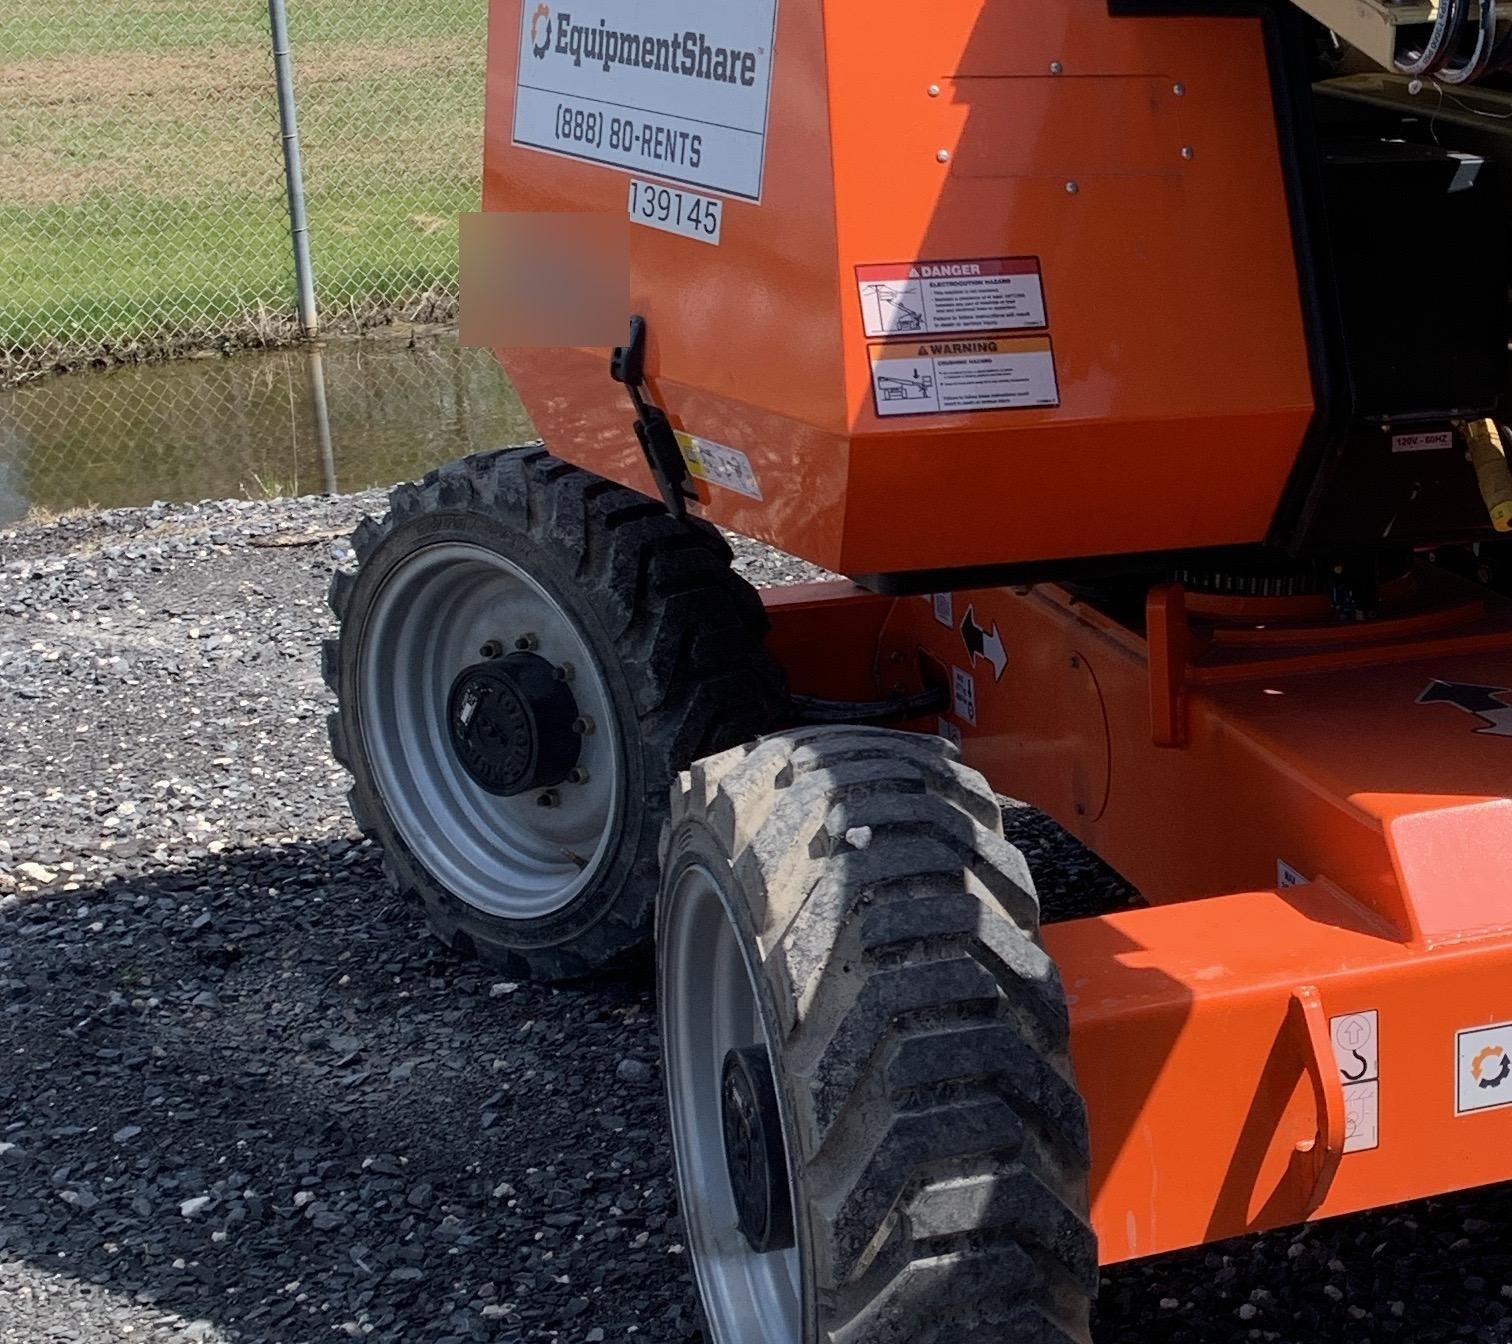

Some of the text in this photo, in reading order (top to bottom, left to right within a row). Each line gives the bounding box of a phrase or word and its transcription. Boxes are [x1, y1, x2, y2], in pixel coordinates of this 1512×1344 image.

[554, 12, 756, 87] EquipmentShare
[554, 103, 702, 169] (888) 80-RENTS
[630, 182, 718, 235] 139145
[921, 264, 981, 277] DANGER
[930, 342, 998, 355] WARNING
